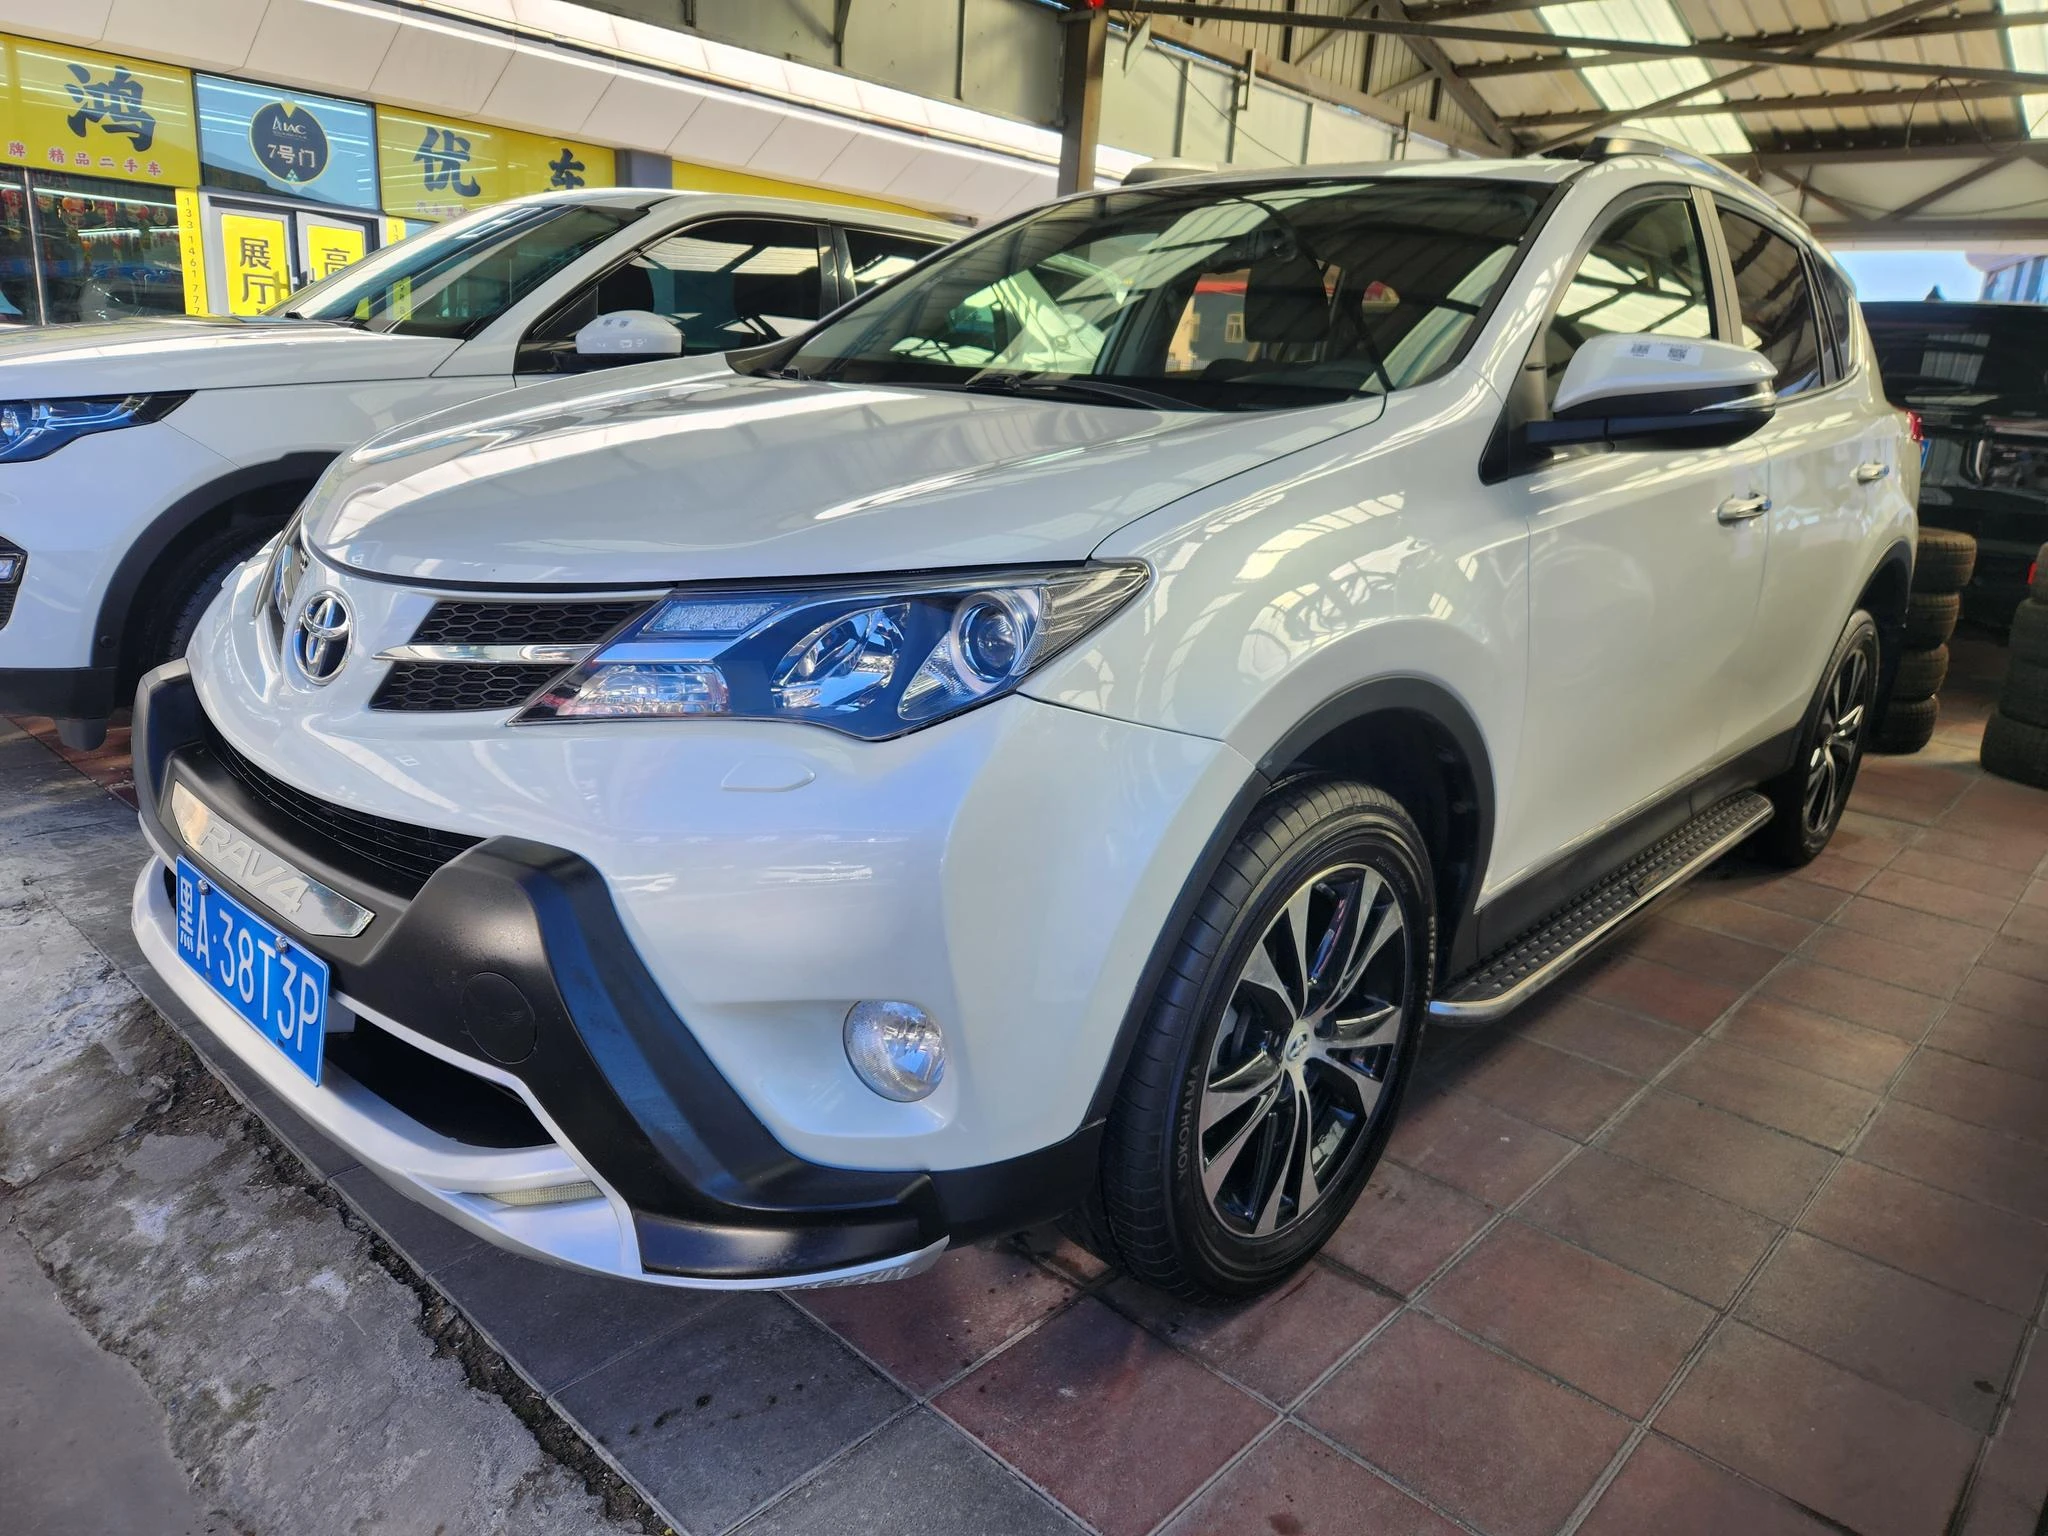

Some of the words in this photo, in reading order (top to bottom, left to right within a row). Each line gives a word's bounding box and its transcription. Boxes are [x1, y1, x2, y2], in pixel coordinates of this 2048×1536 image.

[64, 64, 156, 152] 鸿
[9, 142, 25, 158] 牌
[48, 148, 161, 176] 精品二手车
[267, 143, 316, 168] 7号门
[200, 821, 310, 913] RAV4
[1177, 1064, 1200, 1179] YOKOHAMA
